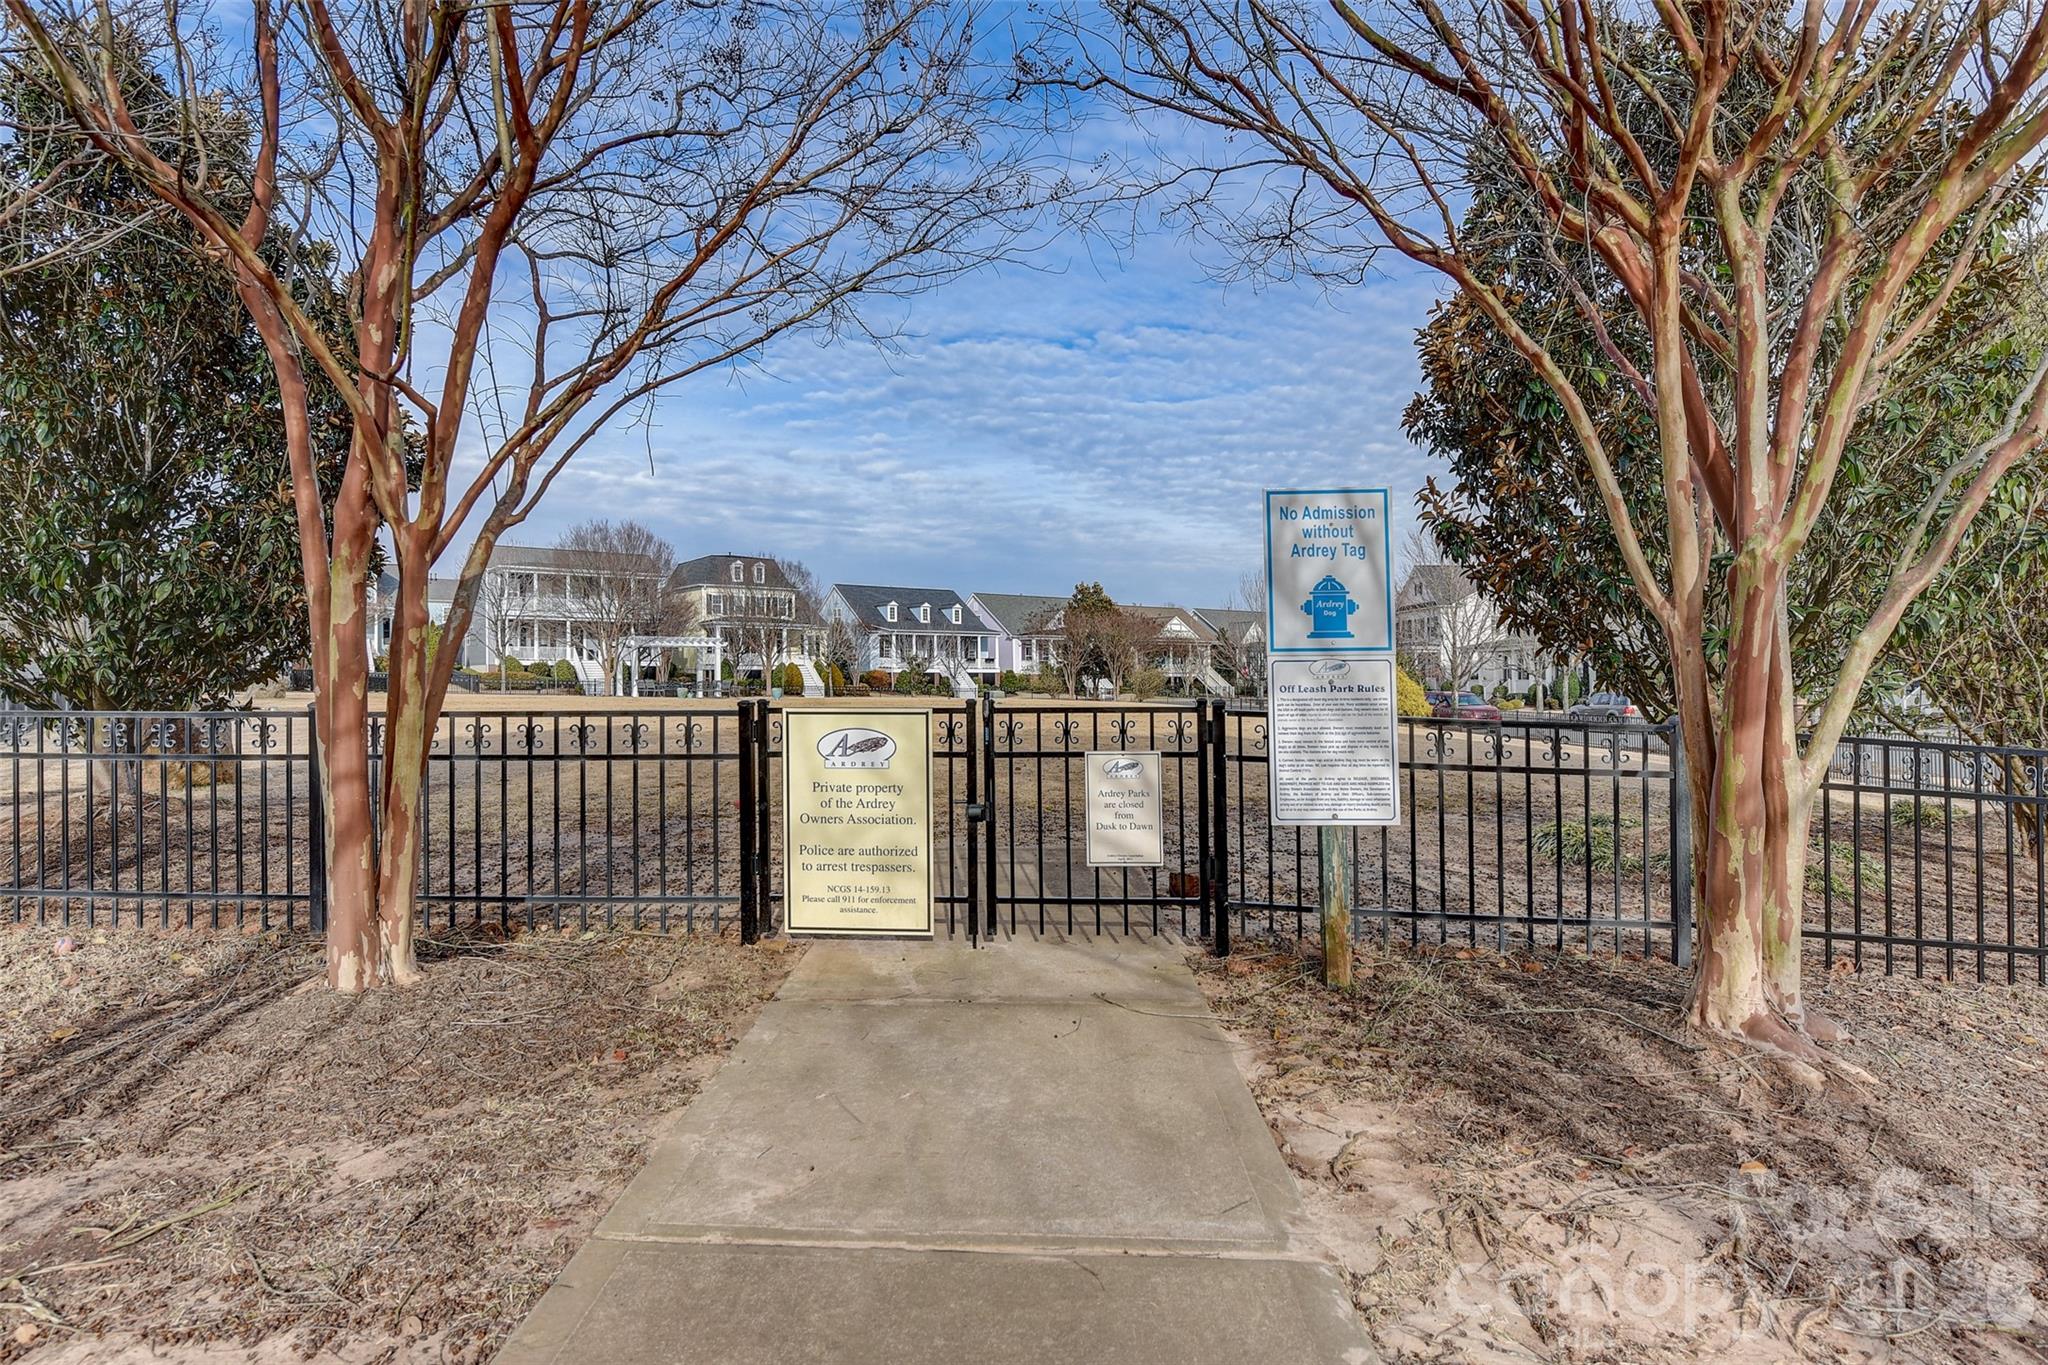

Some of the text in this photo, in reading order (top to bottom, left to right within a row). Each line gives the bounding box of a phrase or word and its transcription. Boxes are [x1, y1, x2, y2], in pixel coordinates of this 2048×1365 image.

[1280, 505, 1375, 520] No Admission
[1302, 524, 1354, 539] without
[1291, 543, 1366, 560] Ardrey Tag
[1316, 600, 1344, 609] Ardrey
[1279, 685, 1385, 693] Off Leash Park Rules
[812, 782, 904, 796] Private property
[1098, 790, 1150, 799] Ardrey Parks
[820, 798, 896, 811] of the Ardrey
[1118, 801, 1144, 809] closed
[800, 812, 917, 825] Owners Association.
[1114, 811, 1134, 819] from
[1096, 822, 1117, 830] Dusk
[1129, 823, 1153, 831] Dawn
[799, 844, 918, 857] Police are authorized
[802, 862, 916, 875] to arrest trespassers.
[827, 885, 891, 894] NCGS 14-159.13
[802, 895, 825, 903] Please
[827, 895, 840, 903] call
[842, 895, 855, 903] 911
[870, 896, 916, 904] enforcement
[839, 906, 878, 914] assistance.
